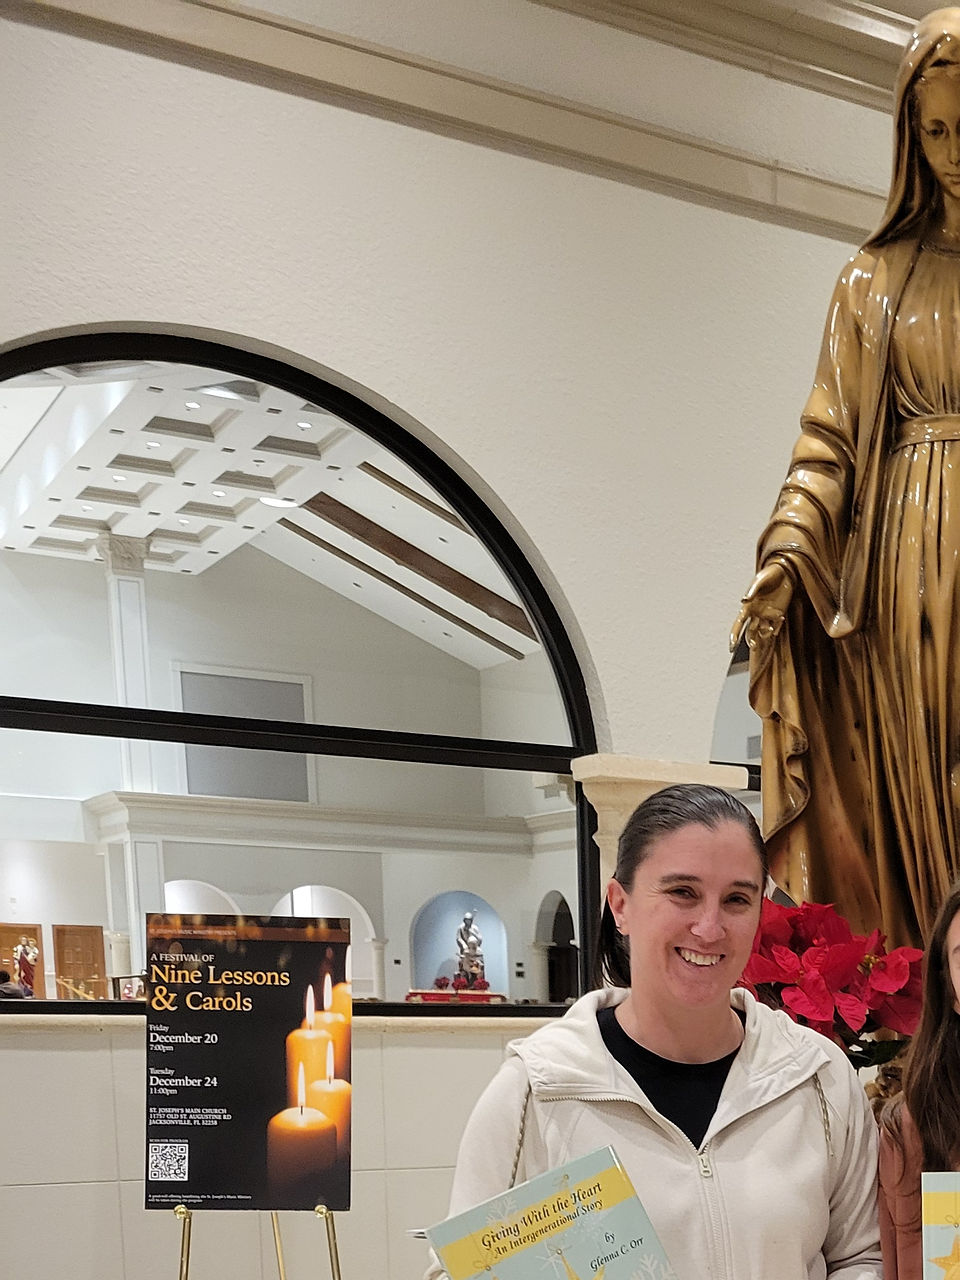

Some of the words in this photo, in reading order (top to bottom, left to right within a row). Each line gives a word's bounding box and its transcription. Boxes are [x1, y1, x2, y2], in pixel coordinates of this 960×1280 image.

[150, 953, 158, 961] A
[159, 953, 201, 962] FESTIVAL
[201, 954, 215, 962] OF
[150, 964, 202, 984] Nine
[207, 965, 290, 986] Lessons
[151, 985, 178, 1011] &
[185, 991, 253, 1012] Carols
[149, 1024, 169, 1032] Friday
[149, 1032, 202, 1043] December
[204, 1033, 218, 1044] 20
[149, 1044, 174, 1052] 7:00pm
[149, 1067, 175, 1076] Tuesday
[149, 1076, 202, 1087] December
[204, 1077, 218, 1087] 24
[149, 1087, 178, 1096] 11:00pm
[481, 1223, 520, 1250] Giving
[520, 1204, 550, 1229] With
[553, 1197, 569, 1213] the
[570, 1182, 602, 1205] Heart
[494, 1246, 508, 1259] An
[509, 1209, 580, 1250] Intergenerational
[581, 1199, 603, 1216] Story
[604, 1231, 615, 1244] by
[590, 1250, 619, 1273] Glenna
[620, 1244, 630, 1255] C.
[630, 1237, 644, 1250] Orr
